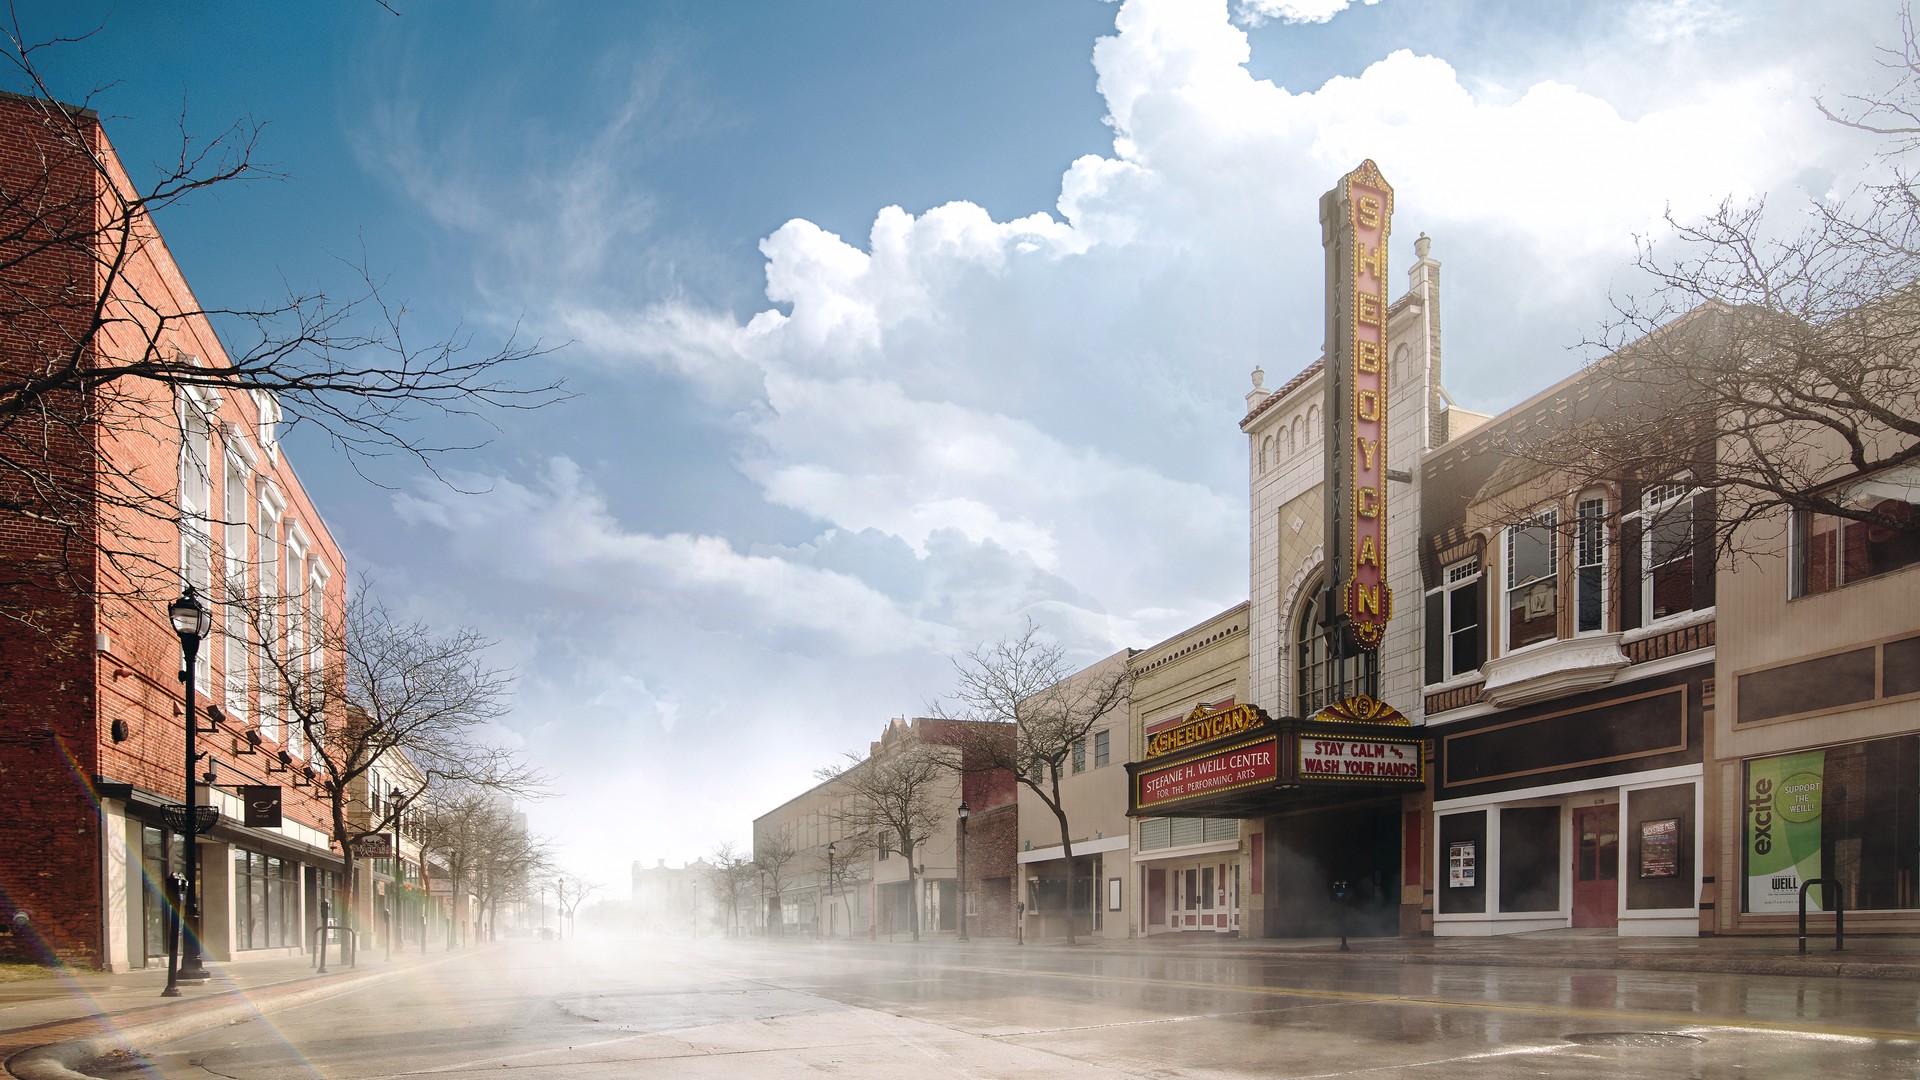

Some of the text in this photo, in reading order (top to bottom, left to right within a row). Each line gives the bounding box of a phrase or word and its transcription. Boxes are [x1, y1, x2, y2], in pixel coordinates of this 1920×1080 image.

[1358, 195, 1380, 614] SHEBOYGAN
[1159, 709, 1243, 751] SHEBOYGAN
[1315, 742, 1403, 759] STAY CALM AND
[1146, 752, 1271, 793] STEFANIE H. WEILL CENTER
[1304, 758, 1417, 776] WASH YOUR HANDS
[1157, 768, 1256, 799] FOR THE PERFORMING ARTS
[1784, 782, 1820, 794] SUPPORT
[1795, 794, 1809, 802] THE
[1748, 779, 1772, 855] excite
[1789, 804, 1815, 813] WEILL!
[1772, 877, 1798, 890] WEILL
